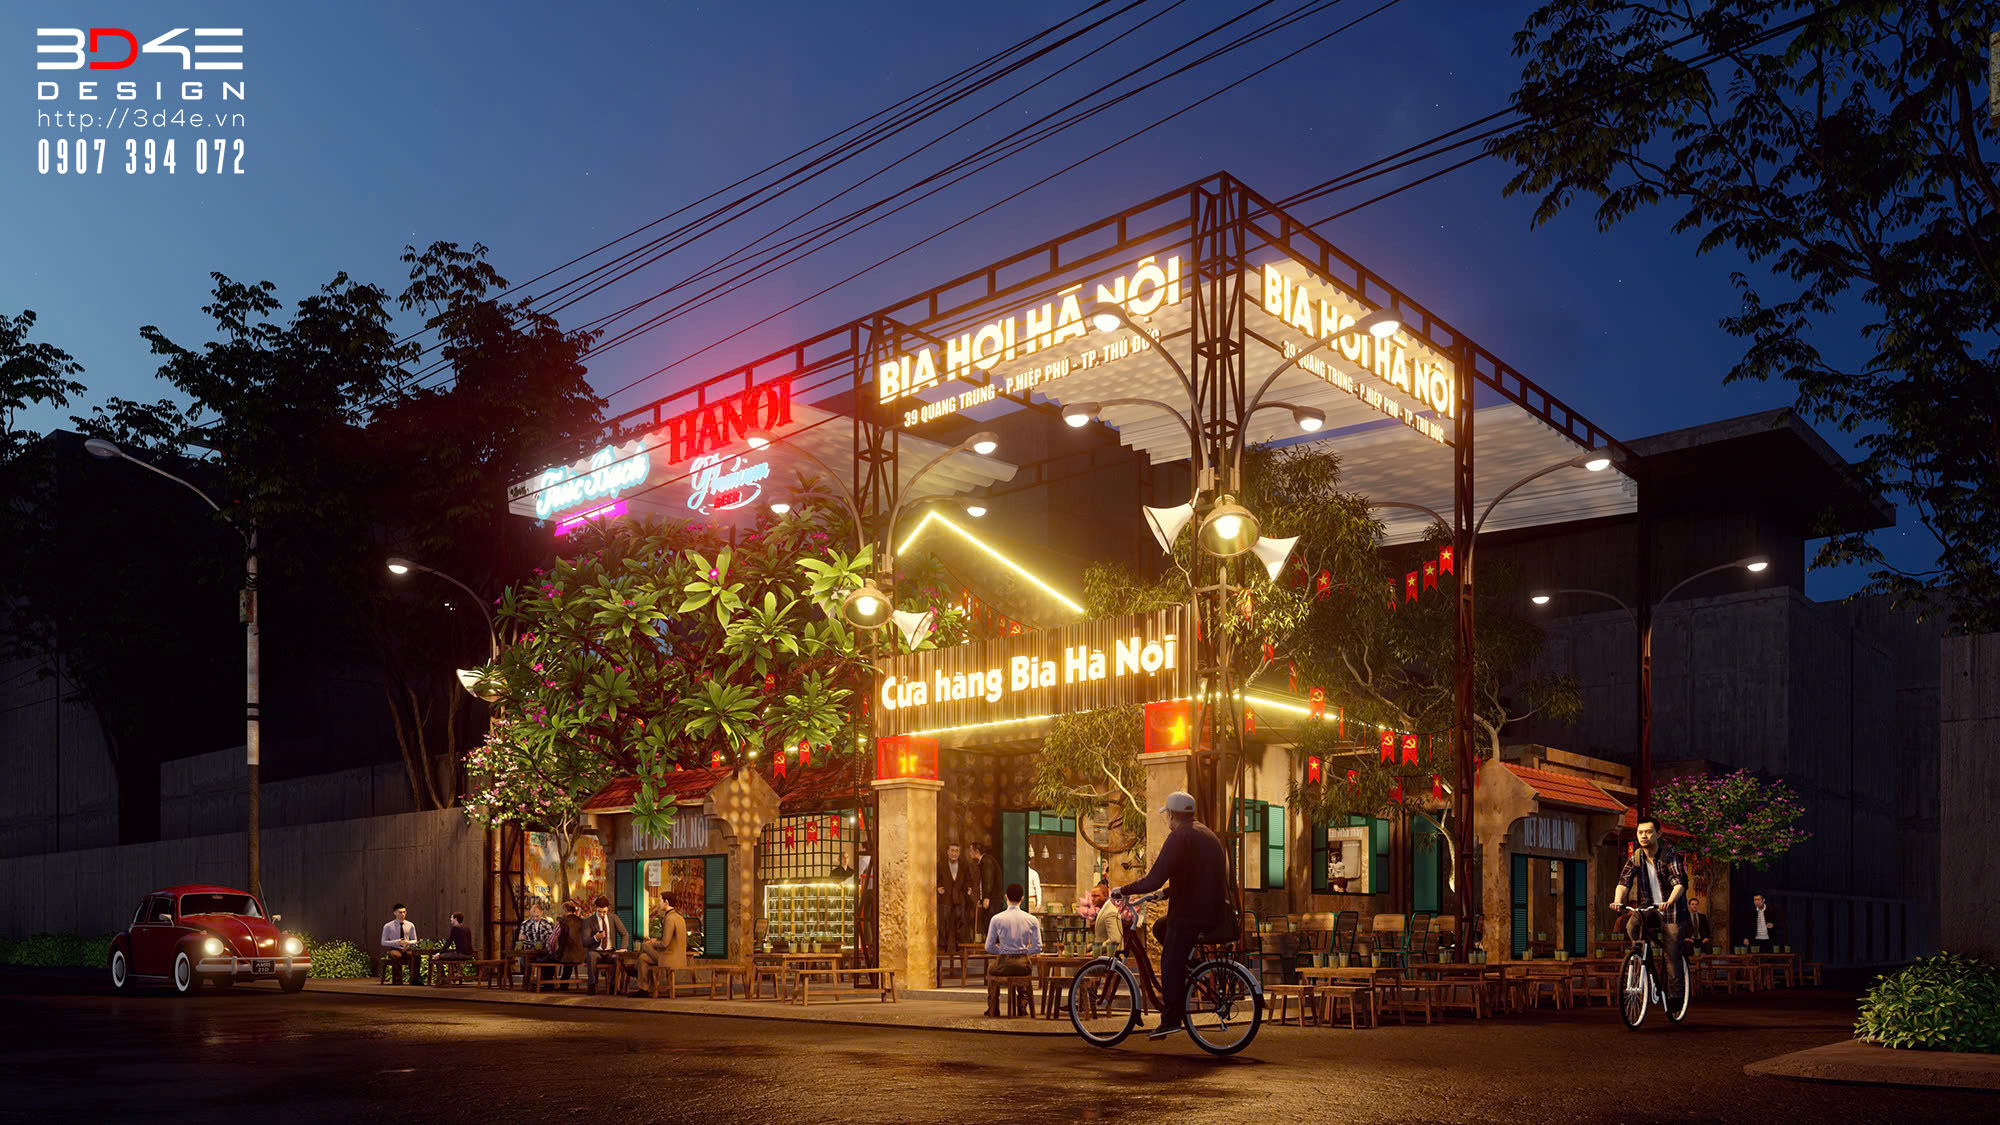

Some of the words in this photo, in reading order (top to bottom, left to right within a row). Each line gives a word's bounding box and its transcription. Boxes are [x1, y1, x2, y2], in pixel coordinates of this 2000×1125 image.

[880, 348, 938, 404] BIA
[947, 316, 1016, 382] HƠI
[1027, 284, 1087, 354] HÀ
[1264, 263, 1314, 338] BIA
[1375, 334, 1409, 393] HÀ
[1415, 356, 1455, 419] NỘI
[1327, 365, 1353, 393] TRUNG
[668, 377, 794, 465] HANOI
[904, 409, 918, 428] 39
[921, 396, 956, 423] QUANG
[959, 383, 995, 409] TRUNG
[1045, 357, 1069, 382] PHÚ
[1081, 350, 1099, 369] TP.
[881, 675, 927, 710] Cửa
[935, 668, 1002, 702] hàng
[1011, 655, 1056, 691] Bia
[1065, 645, 1106, 683] Hà
[1115, 635, 1176, 677] Nội
